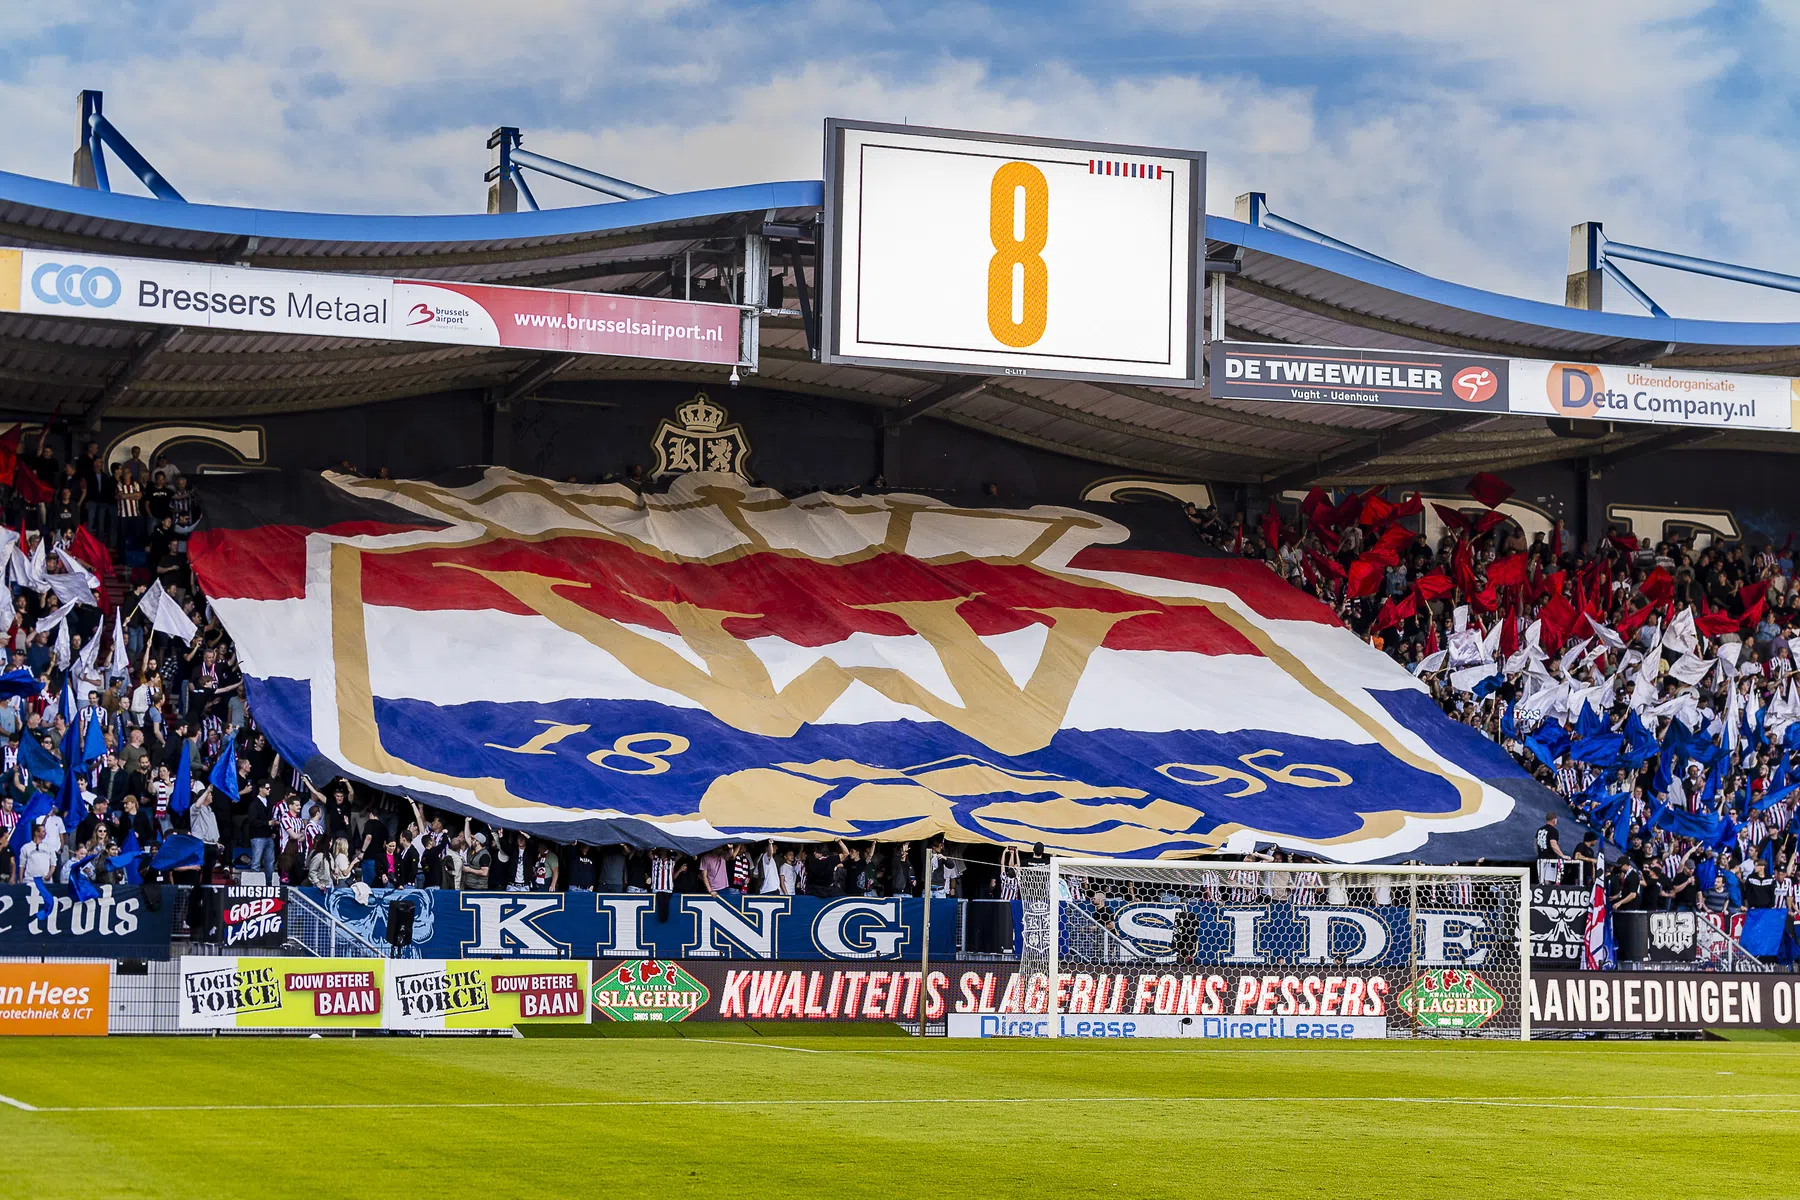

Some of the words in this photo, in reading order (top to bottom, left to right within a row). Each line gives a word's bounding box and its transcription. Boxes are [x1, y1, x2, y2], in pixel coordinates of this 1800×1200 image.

[987, 161, 1049, 348] 8
[138, 280, 276, 317] Bressers
[287, 292, 388, 324] Metaal
[436, 307, 469, 317] brussels
[435, 315, 463, 324] airport
[513, 311, 724, 342] www.brusselsairport.nl
[1225, 358, 1261, 380] DE
[1265, 360, 1443, 390] TWEEWIELER
[1627, 373, 1735, 393] Uitzendorganisatie
[1291, 388, 1321, 401] Vught
[1331, 391, 1379, 403] Udenhout
[1562, 367, 1629, 411] Deta
[1633, 391, 1757, 422] Company.nl
[484, 719, 690, 775] 18
[1153, 748, 1354, 799] 96
[228, 886, 281, 898] KINGSIDE
[26, 881, 140, 936] trots
[229, 898, 275, 922] GOED
[227, 913, 282, 946] LASTIG
[461, 893, 911, 960] KING
[1117, 904, 1494, 967] SIDE
[1651, 931, 1694, 954] boys
[27, 981, 91, 1005] Hees
[187, 967, 275, 994] LOGISTIC
[289, 975, 323, 990] JOUW
[326, 973, 370, 989] BETERE
[400, 969, 481, 996] LOGISTIC
[495, 977, 529, 992] JOUW
[531, 975, 573, 991] BETERE
[190, 984, 279, 1015] FORCE
[319, 991, 375, 1015] BAAN
[401, 986, 486, 1017] FORCE
[525, 992, 578, 1017] BAAN
[598, 990, 699, 1012] SLAGERIJ
[719, 970, 949, 1019] KWALITEITS
[955, 971, 1128, 1014] SLAGERIJ
[1133, 974, 1228, 1015] FONS
[1234, 976, 1389, 1016] PESSERS
[1529, 979, 1762, 1024] AANBIEDINGEN
[1773, 981, 1800, 1024] O
[61, 1008, 71, 1020] &
[73, 1008, 94, 1020] ICT
[980, 1015, 1137, 1038] DirecLease
[1203, 1017, 1355, 1039] DirectLease
